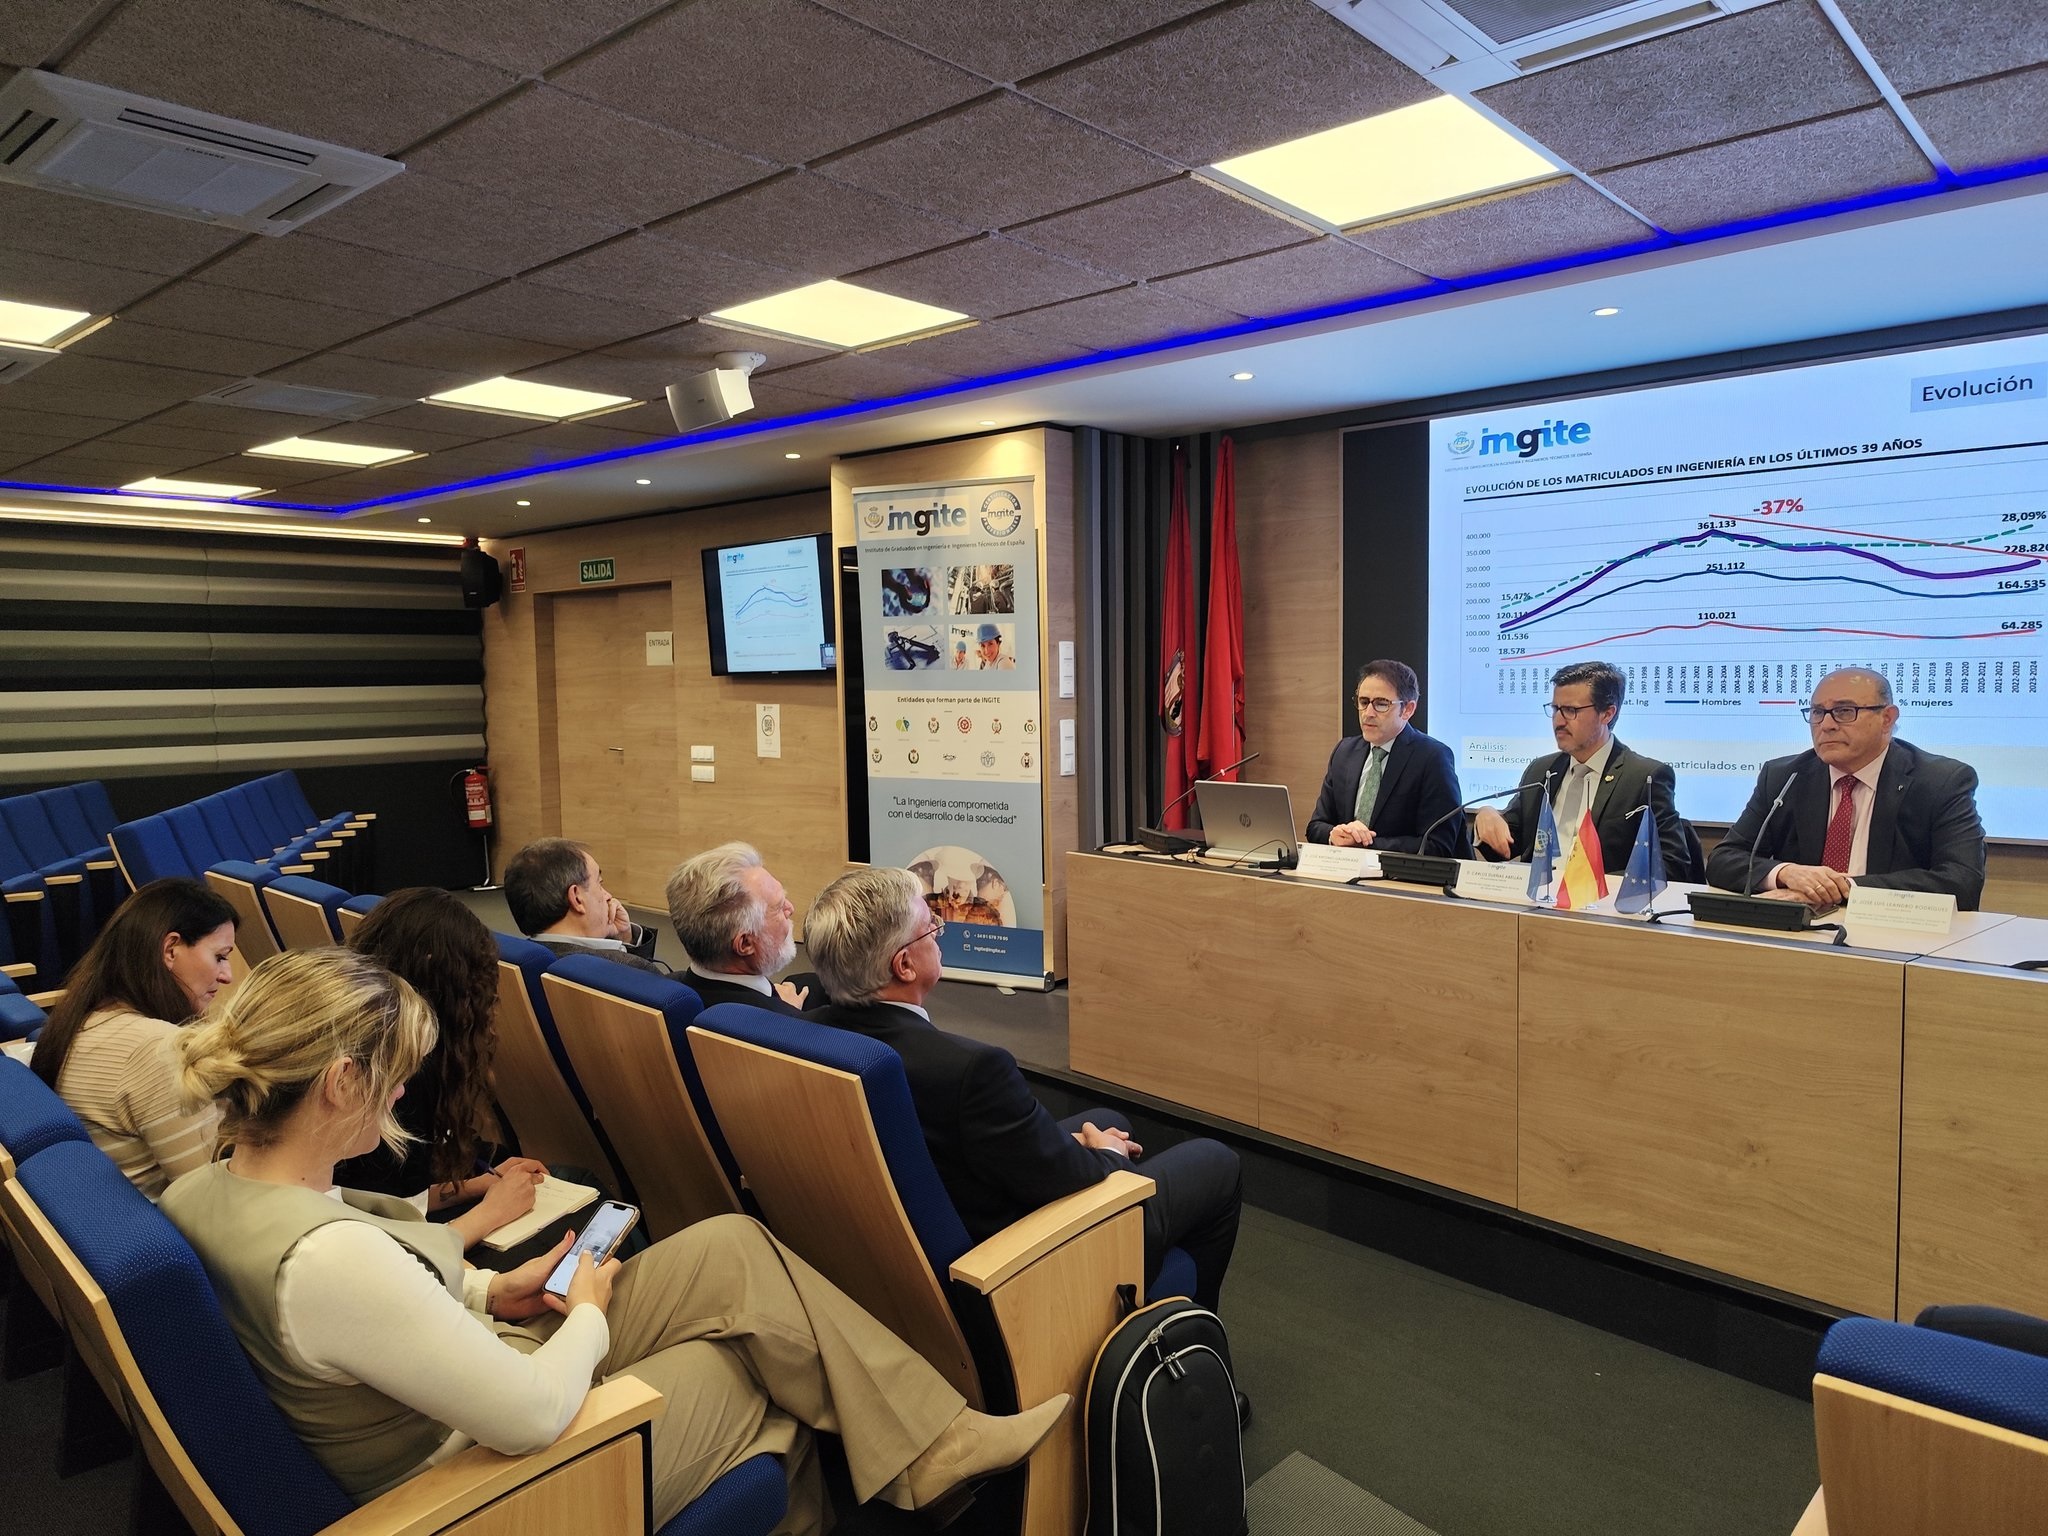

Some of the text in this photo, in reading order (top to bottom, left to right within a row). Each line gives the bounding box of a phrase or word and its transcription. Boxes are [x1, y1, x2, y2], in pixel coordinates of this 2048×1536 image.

[1922, 376, 2033, 401] Evolución
[1479, 419, 1591, 458] ingite
[1466, 438, 1923, 494] EVOLUCIÓN DE LOS MATRICULADOS EN INGENIERÍA EN LOS ÚLTIMOS 39 AÑOS
[1753, 498, 1804, 516] -37%
[888, 502, 966, 536] ingite
[2001, 510, 2047, 523] 28,09%
[1698, 520, 1736, 530] 361.133
[583, 563, 612, 579] SALIDA
[1706, 562, 1745, 572] 251.112
[1997, 580, 2046, 590] 164.535
[1502, 592, 1530, 602] 15,47%
[1698, 611, 1736, 620] 110.021
[2001, 620, 2042, 630] 64.285
[1928, 662, 1936, 693] 2017-2018
[1961, 662, 1969, 693] 2019-2020
[1978, 662, 1986, 693] 2020-2021
[1995, 662, 2003, 693] 2021-2022
[2012, 661, 2020, 693] 2022-2023
[1636, 699, 1649, 707] Ing
[1912, 700, 1953, 708] mujeres
[1469, 742, 1507, 750] Análisis:
[948, 801, 1009, 811] comprometida
[905, 810, 912, 819] el
[914, 811, 953, 821] desarrollo
[954, 812, 965, 822] de
[967, 813, 974, 822] la
[976, 815, 1017, 824] sociedad"
[1240, 813, 1252, 828] hp
